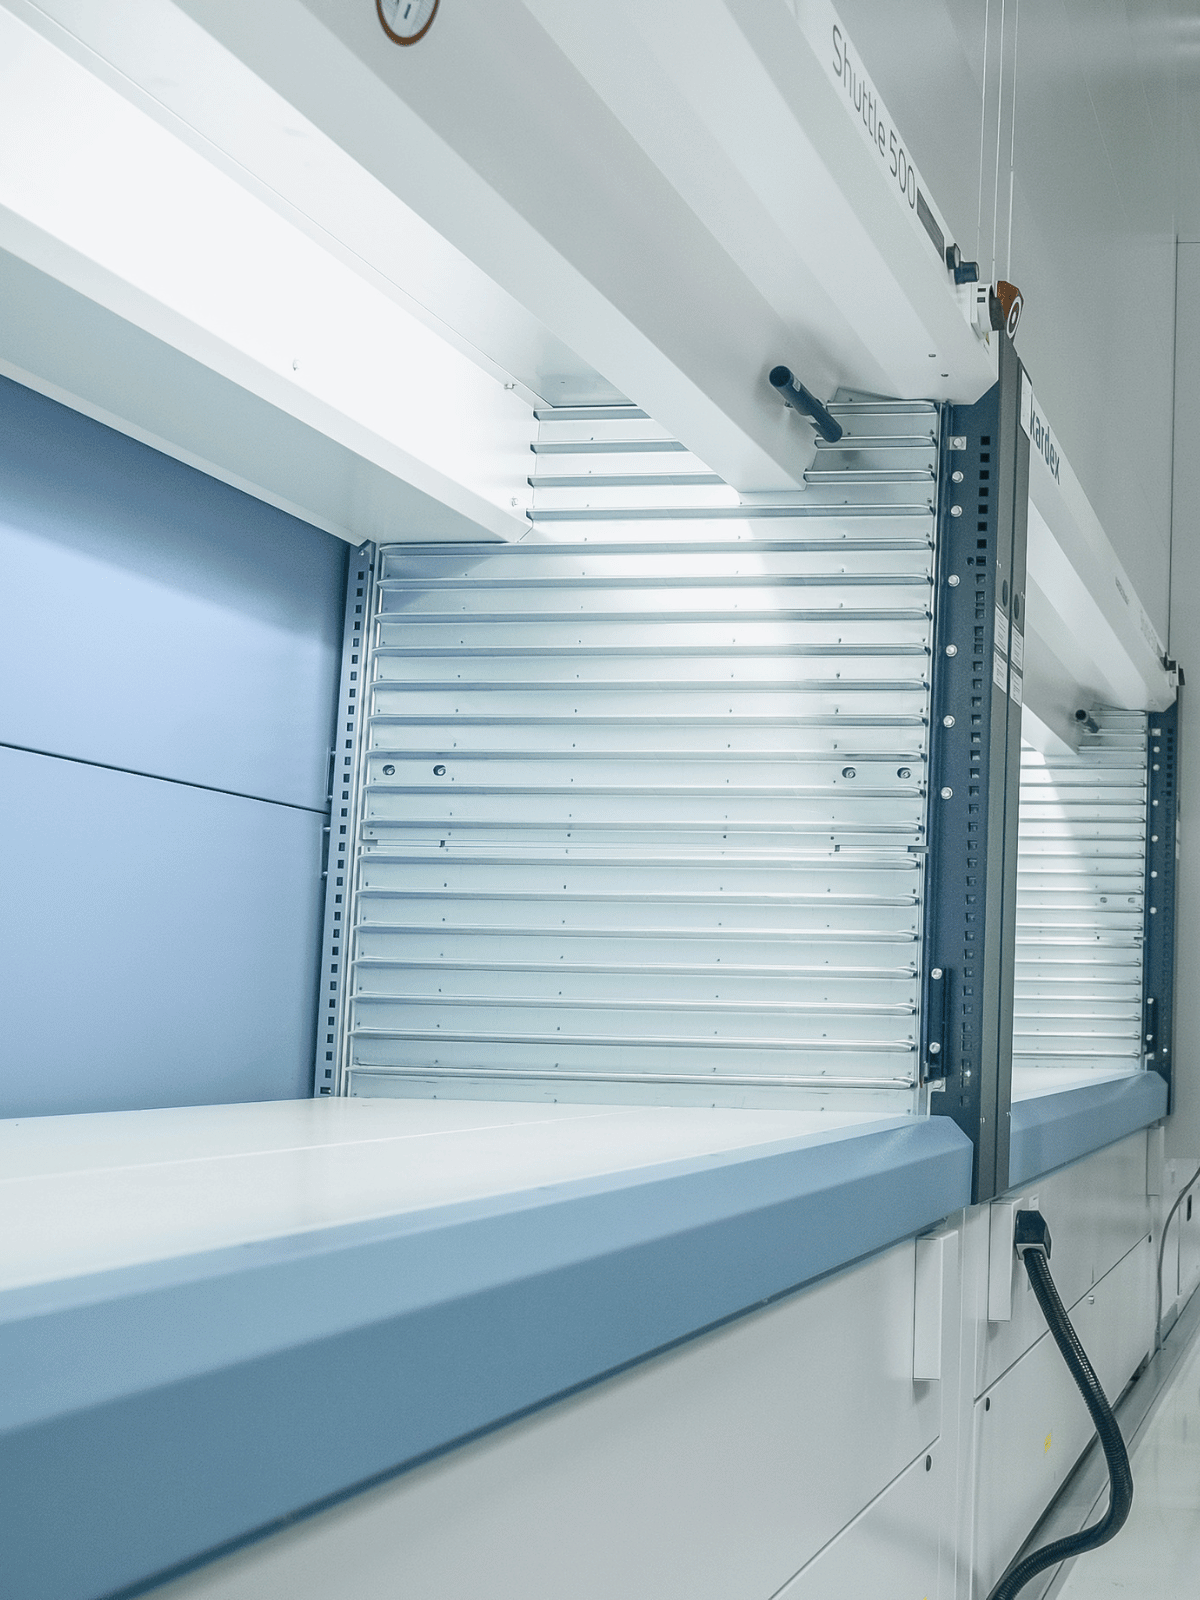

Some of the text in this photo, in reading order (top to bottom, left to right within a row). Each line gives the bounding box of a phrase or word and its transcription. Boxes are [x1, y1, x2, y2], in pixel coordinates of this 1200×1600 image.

[832, 24, 916, 210] Shuttle 500
[1029, 394, 1060, 486] kardex
